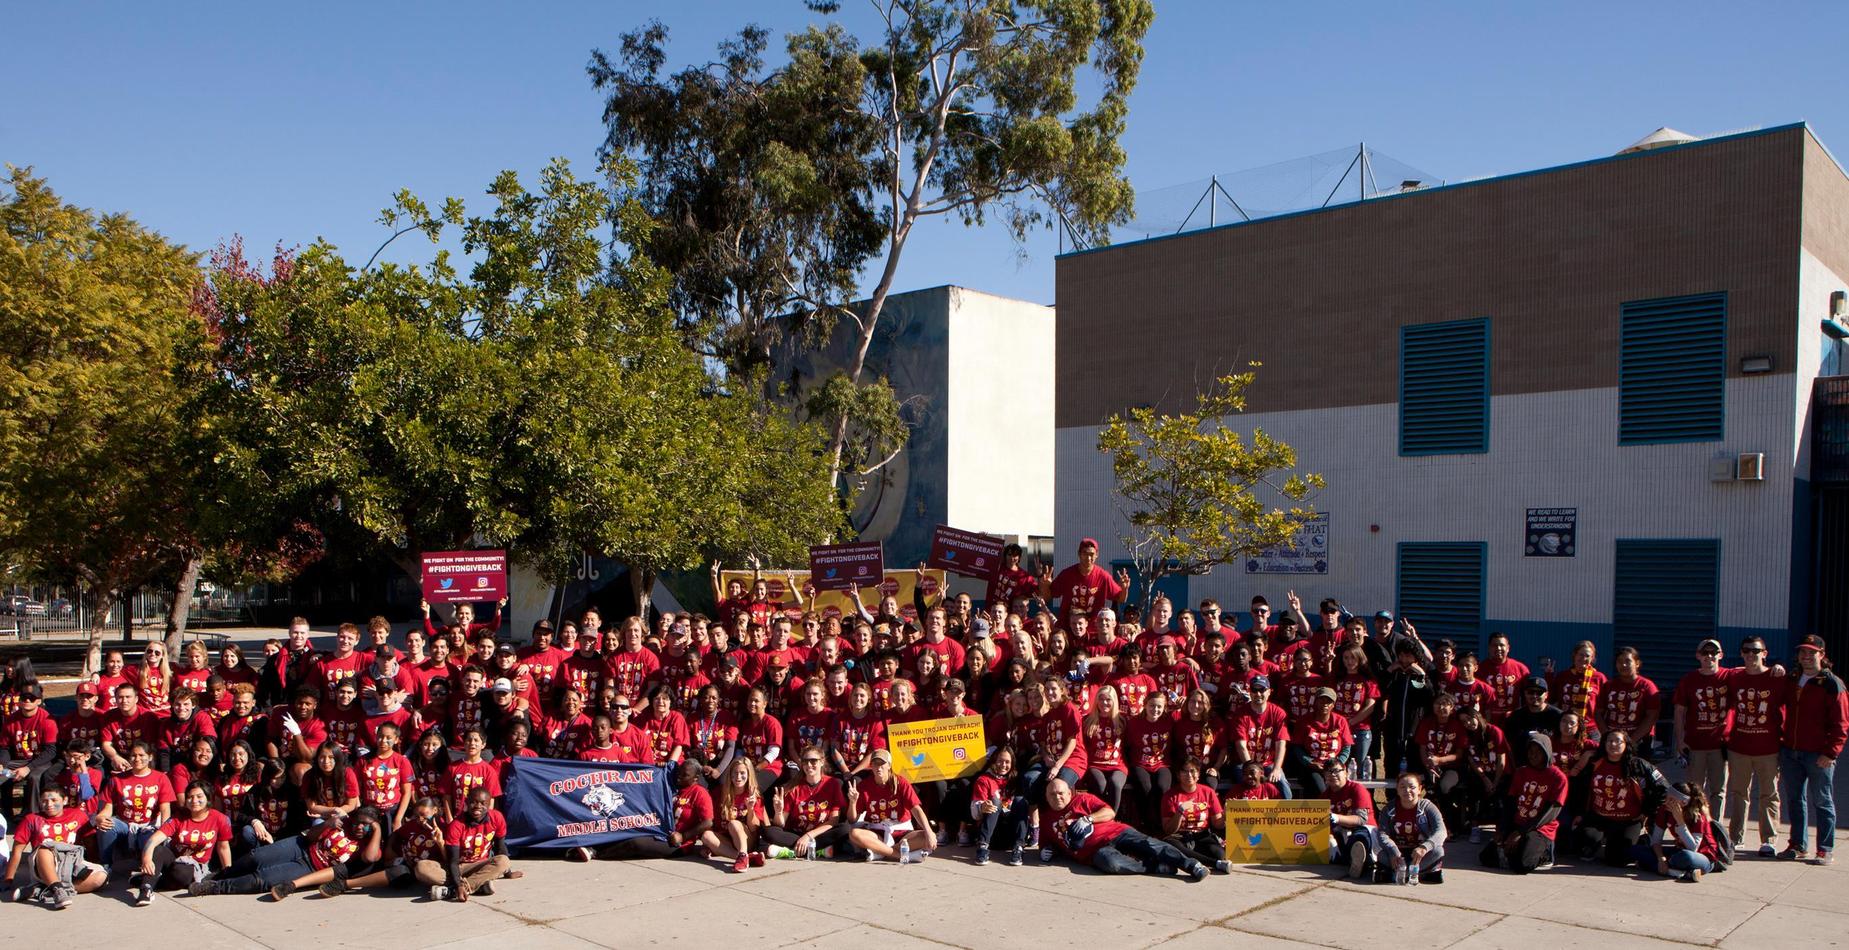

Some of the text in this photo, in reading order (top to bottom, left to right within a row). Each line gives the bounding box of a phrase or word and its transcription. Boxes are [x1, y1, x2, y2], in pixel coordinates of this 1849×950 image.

[938, 537, 999, 556] #FIGHTONGIVEBACK
[816, 553, 879, 564] #FIGHTONGIVEBACK
[1305, 549, 1326, 560] Respect
[429, 564, 502, 573] #FIGHTONGIVEBACK
[949, 722, 980, 730] OUTREACH!
[897, 732, 979, 748] #FIGHTONGIVEBACK
[550, 770, 654, 796] COCHRAN
[557, 813, 661, 838] MIDDLE SCHOOL
